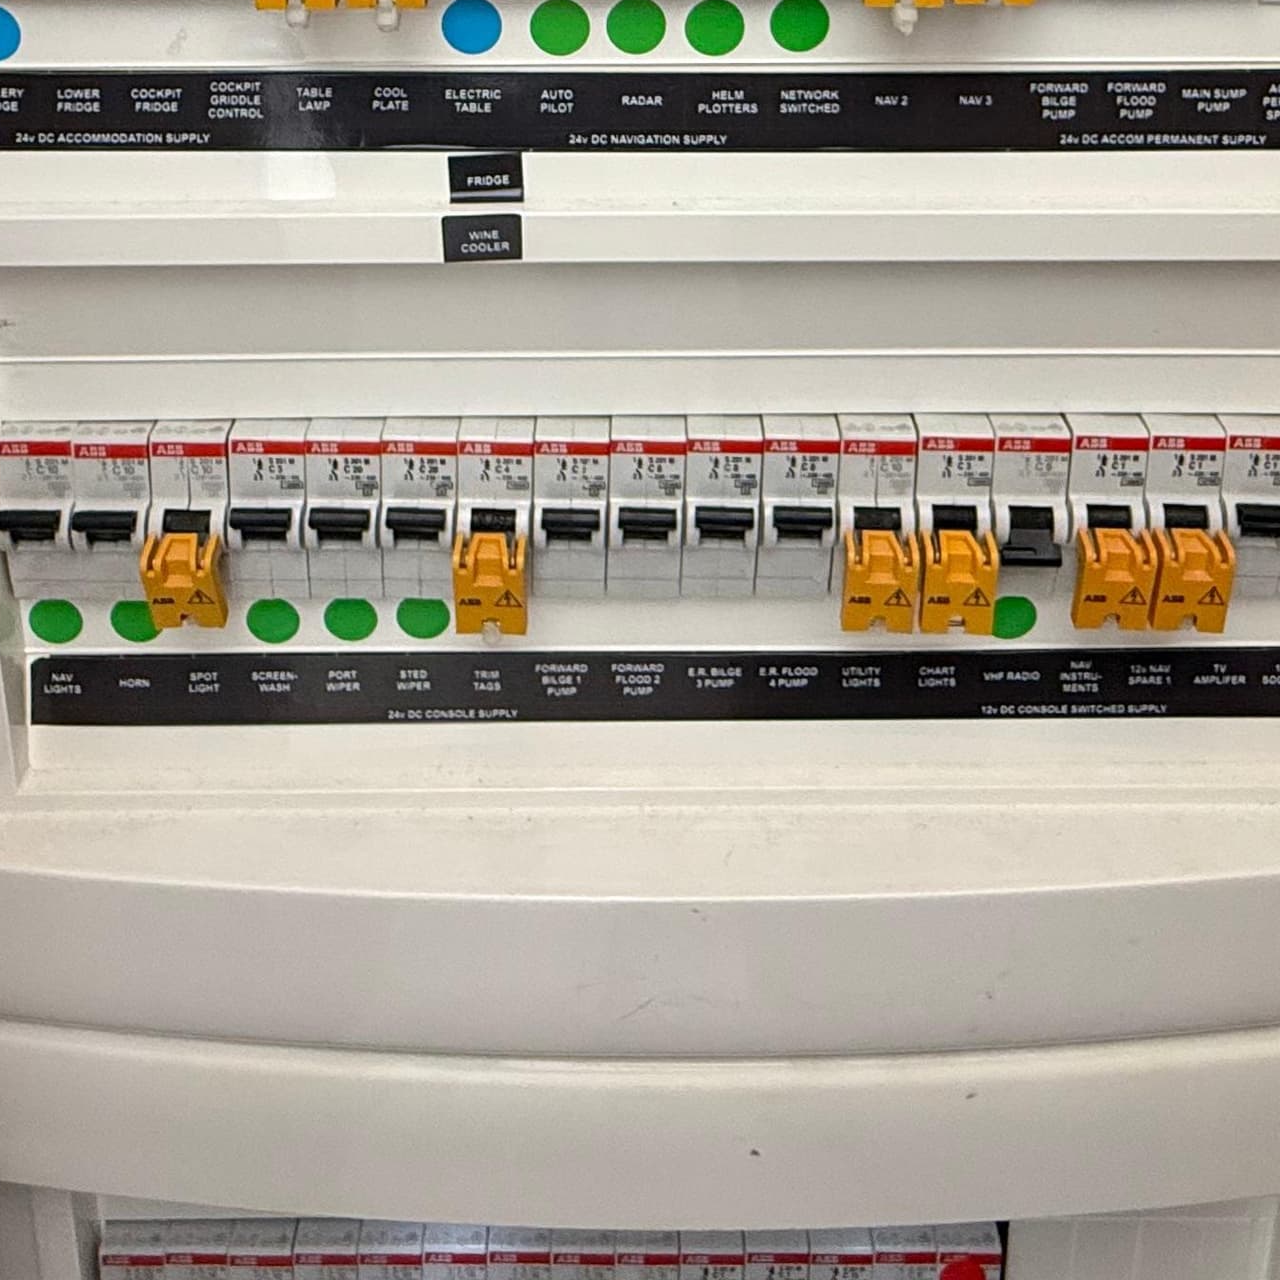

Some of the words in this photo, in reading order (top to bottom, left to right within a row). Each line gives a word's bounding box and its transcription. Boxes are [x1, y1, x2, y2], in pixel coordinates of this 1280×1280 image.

[374, 87, 408, 98] COOL
[445, 89, 501, 100] ELECTRIC
[541, 89, 573, 100] AUTO
[712, 90, 744, 100] HELM
[781, 90, 839, 100] NETWORK
[372, 100, 409, 111] PLATE
[622, 95, 662, 106] RADAR
[875, 96, 898, 105] NAV
[900, 95, 908, 106] 2
[959, 96, 982, 105] NAV
[985, 95, 992, 106] 3
[455, 102, 491, 113] TABLE
[540, 102, 574, 113] PILOT
[698, 103, 758, 114] PLOTTERS
[780, 103, 840, 114] SWITCHED
[569, 134, 588, 144] 24v
[591, 134, 608, 145] DC
[610, 134, 680, 145] NAVIGATION
[683, 134, 727, 145] SUPPLY
[467, 174, 510, 186] FRIDGE
[469, 230, 499, 240] WINE
[461, 241, 510, 253] COOLER
[2, 444, 28, 454] ABB
[387, 442, 413, 452] ABB
